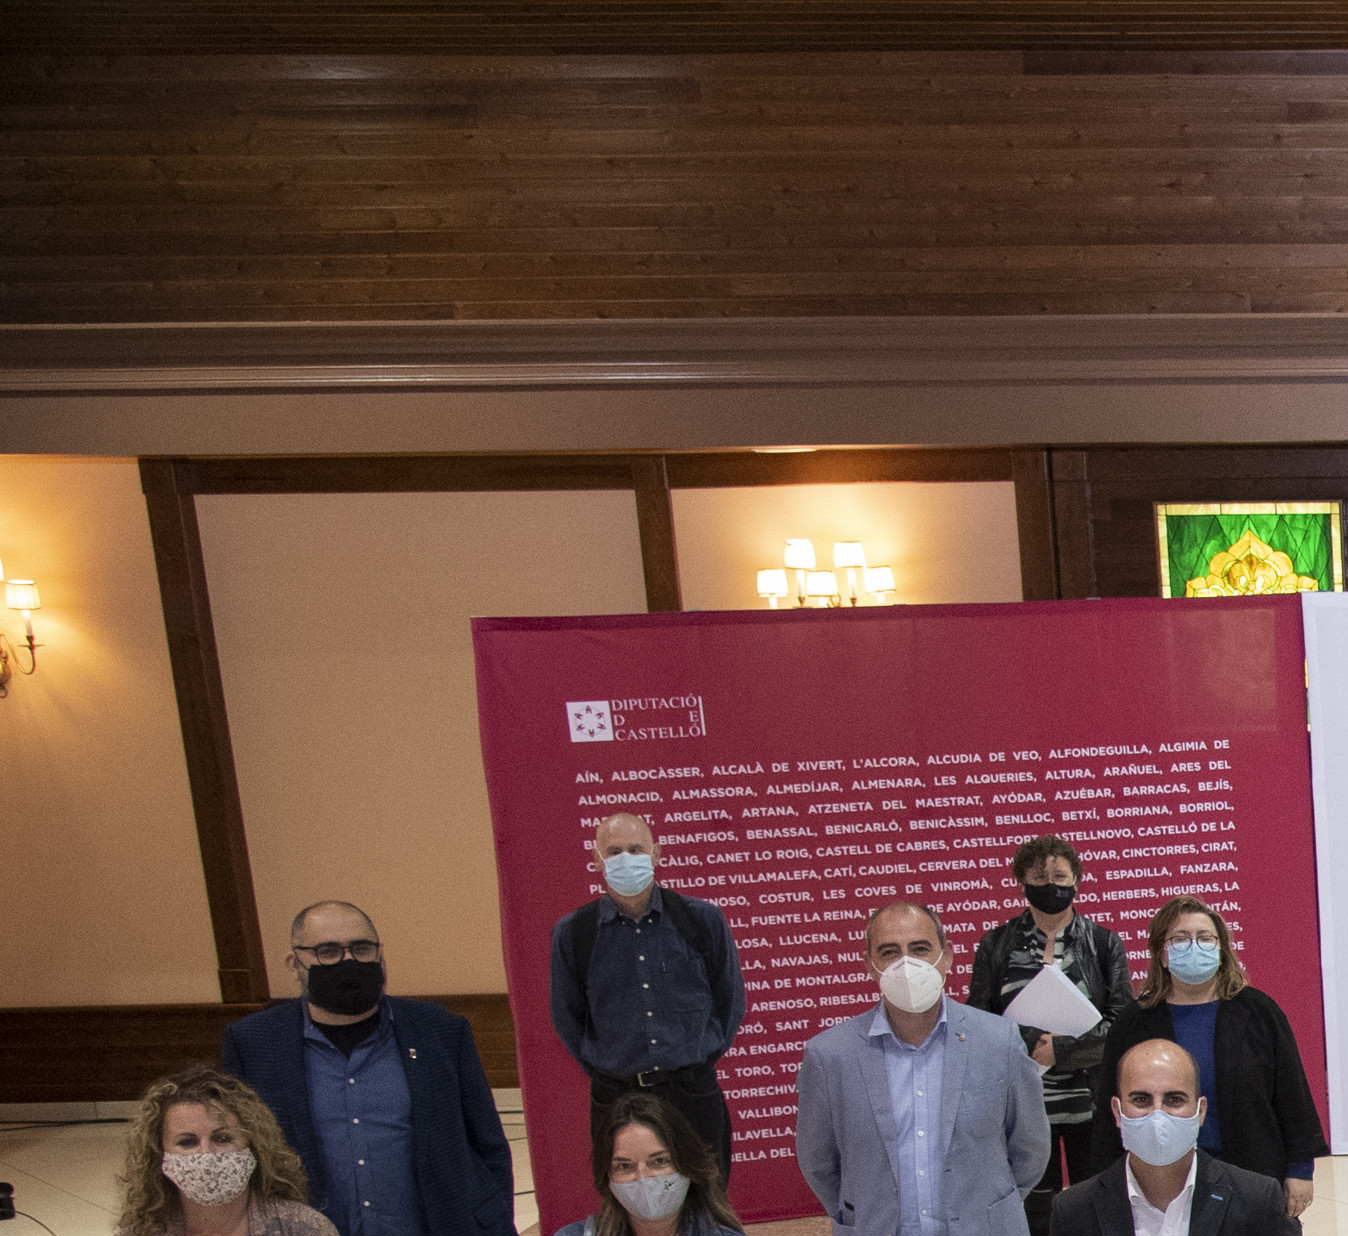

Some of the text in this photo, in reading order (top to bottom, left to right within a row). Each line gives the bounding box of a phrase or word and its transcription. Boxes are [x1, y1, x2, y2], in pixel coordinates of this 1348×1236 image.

[611, 693, 698, 711] DIPUTACIÓ
[613, 710, 700, 727] D E
[615, 722, 700, 741] CASTELLÓ
[771, 762, 790, 773] DE
[797, 759, 846, 772] XIVERT,
[927, 753, 982, 765] ALCUDIA
[988, 751, 1006, 762] DE
[1012, 750, 1042, 761] VEO,
[1048, 744, 1153, 759] ALFONDEGUILLA,
[1158, 740, 1208, 753] ALGIMIA
[1213, 739, 1230, 750] DE
[578, 791, 664, 806] ALMONACID,
[672, 786, 758, 800] ALMASSORA,
[851, 777, 926, 790] ALMENARA,
[934, 775, 957, 786] LES
[965, 771, 1037, 785] ALQUERIES,
[1045, 768, 1096, 781] ALTURA,
[1170, 761, 1202, 773] ARES
[1208, 759, 1232, 771] DEL
[664, 809, 733, 823] ARGELITA,
[742, 805, 799, 818] ARTANA,
[808, 801, 874, 814] ATZENETA
[882, 799, 907, 811] DEL
[915, 795, 984, 808] MAESTRAT,
[1122, 783, 1191, 797] BARRACAS,
[658, 830, 739, 846] BENAFIGOS,
[746, 826, 818, 840] BENASSAL,
[995, 812, 1055, 826] BENLLOC,
[1106, 805, 1173, 819] BORRIANA,
[1179, 800, 1235, 814] BORRIOL,
[706, 851, 751, 864] CANET
[776, 848, 813, 860] ROIG,
[815, 844, 872, 857] CASTELL
[896, 839, 950, 852] CABRES,
[728, 869, 822, 884] VILLAMALEFA,
[858, 863, 917, 876] CAUDIEL,
[918, 859, 977, 872] CERVERA
[1121, 843, 1200, 859] CINCTORRES,
[1200, 840, 1237, 853] CIRAT,
[758, 891, 814, 904] COSTUR,
[822, 889, 846, 900] LES
[854, 885, 897, 898] COVES
[1105, 866, 1173, 881] ESPADILLA,
[1179, 861, 1239, 875] FANZARA,
[751, 913, 802, 926] FUENTE
[823, 909, 867, 921] REINA,
[1102, 887, 1159, 901] HERBERS,
[1160, 882, 1223, 899] HIGUERAS,
[779, 922, 977, 946] LLUCENA, MATA
[771, 954, 833, 968] NAVAJAS,
[751, 997, 817, 1012] ARENOSO,
[775, 1019, 809, 1032] SANT
[735, 1065, 775, 1077] TORO,
[723, 1084, 800, 1100] TORRECHIV
